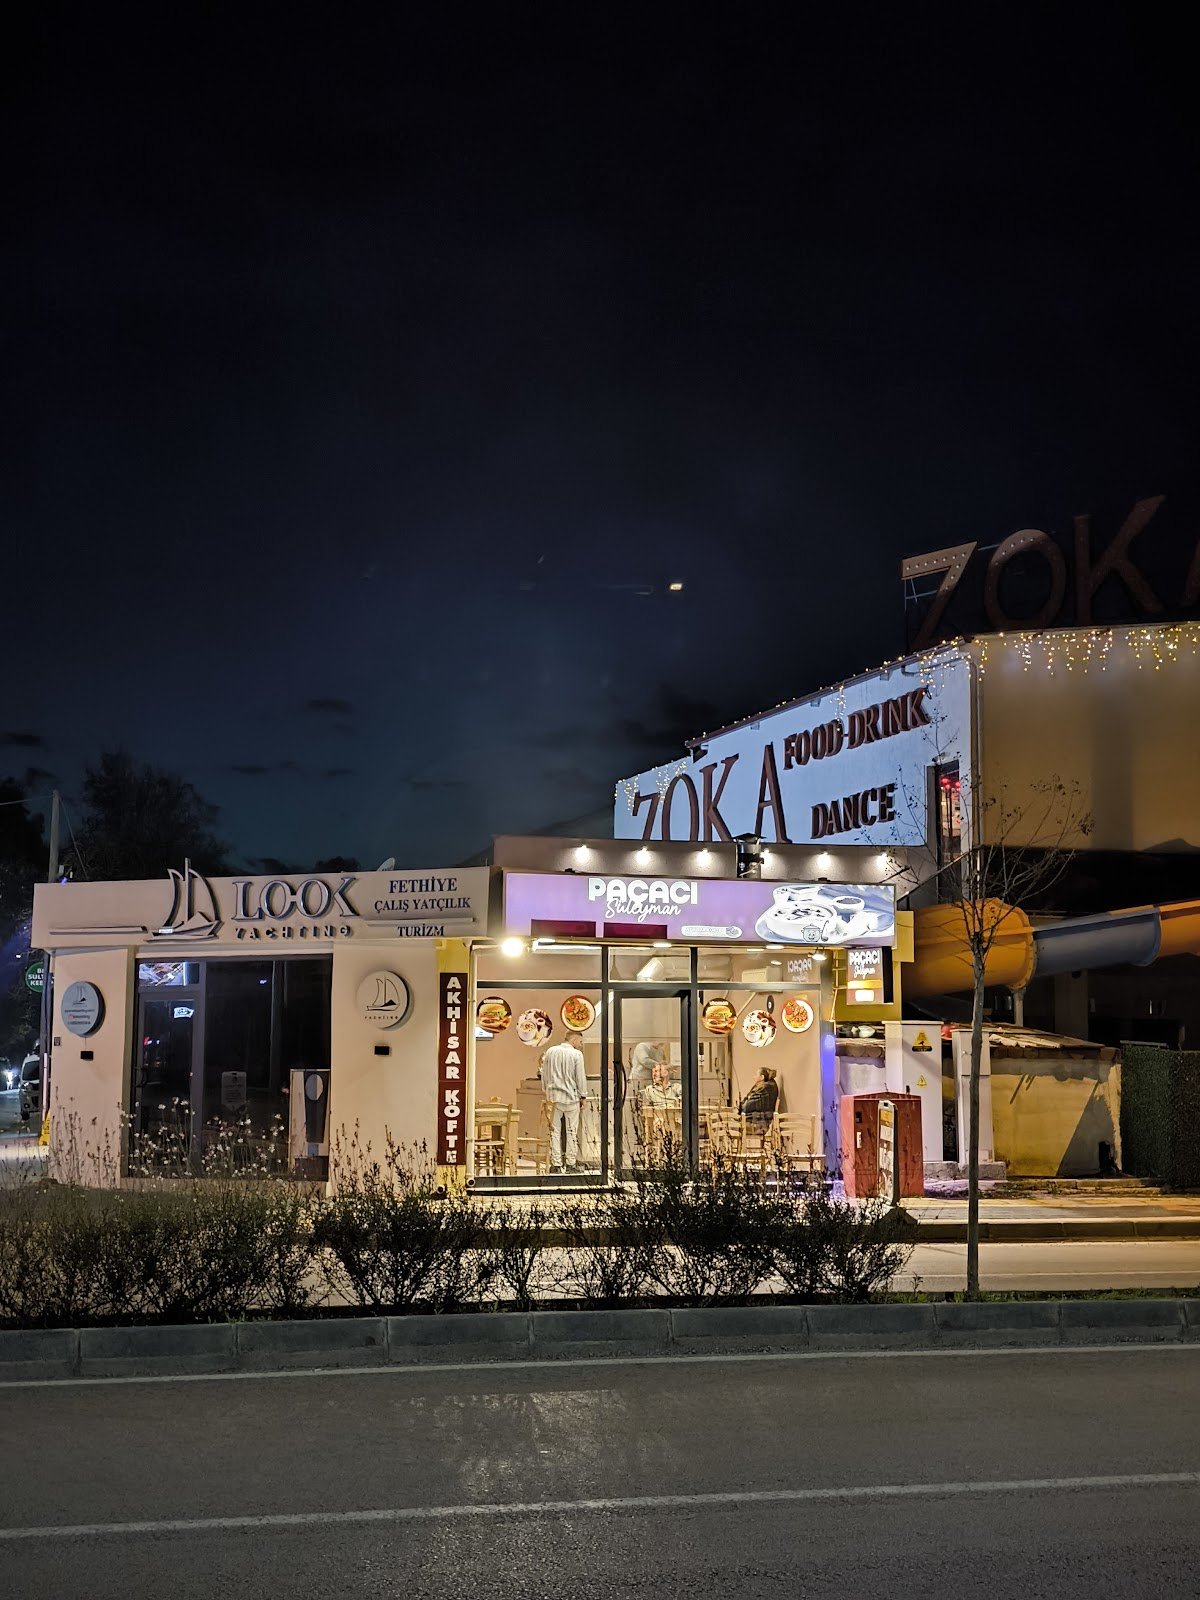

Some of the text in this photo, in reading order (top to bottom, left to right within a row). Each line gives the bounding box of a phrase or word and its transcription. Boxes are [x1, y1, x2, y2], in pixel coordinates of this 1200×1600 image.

[902, 495, 1200, 651] ZOK
[811, 782, 897, 840] DANCE
[231, 877, 360, 921] LOOK
[374, 897, 471, 913] ÇALIŞ YATÇILIK
[389, 876, 458, 894] FETHİYE
[235, 925, 354, 940] YACHTING
[397, 923, 445, 937] TURİZM
[444, 976, 462, 1080] AKHİSAR
[443, 1089, 461, 1164] KÖFTE
